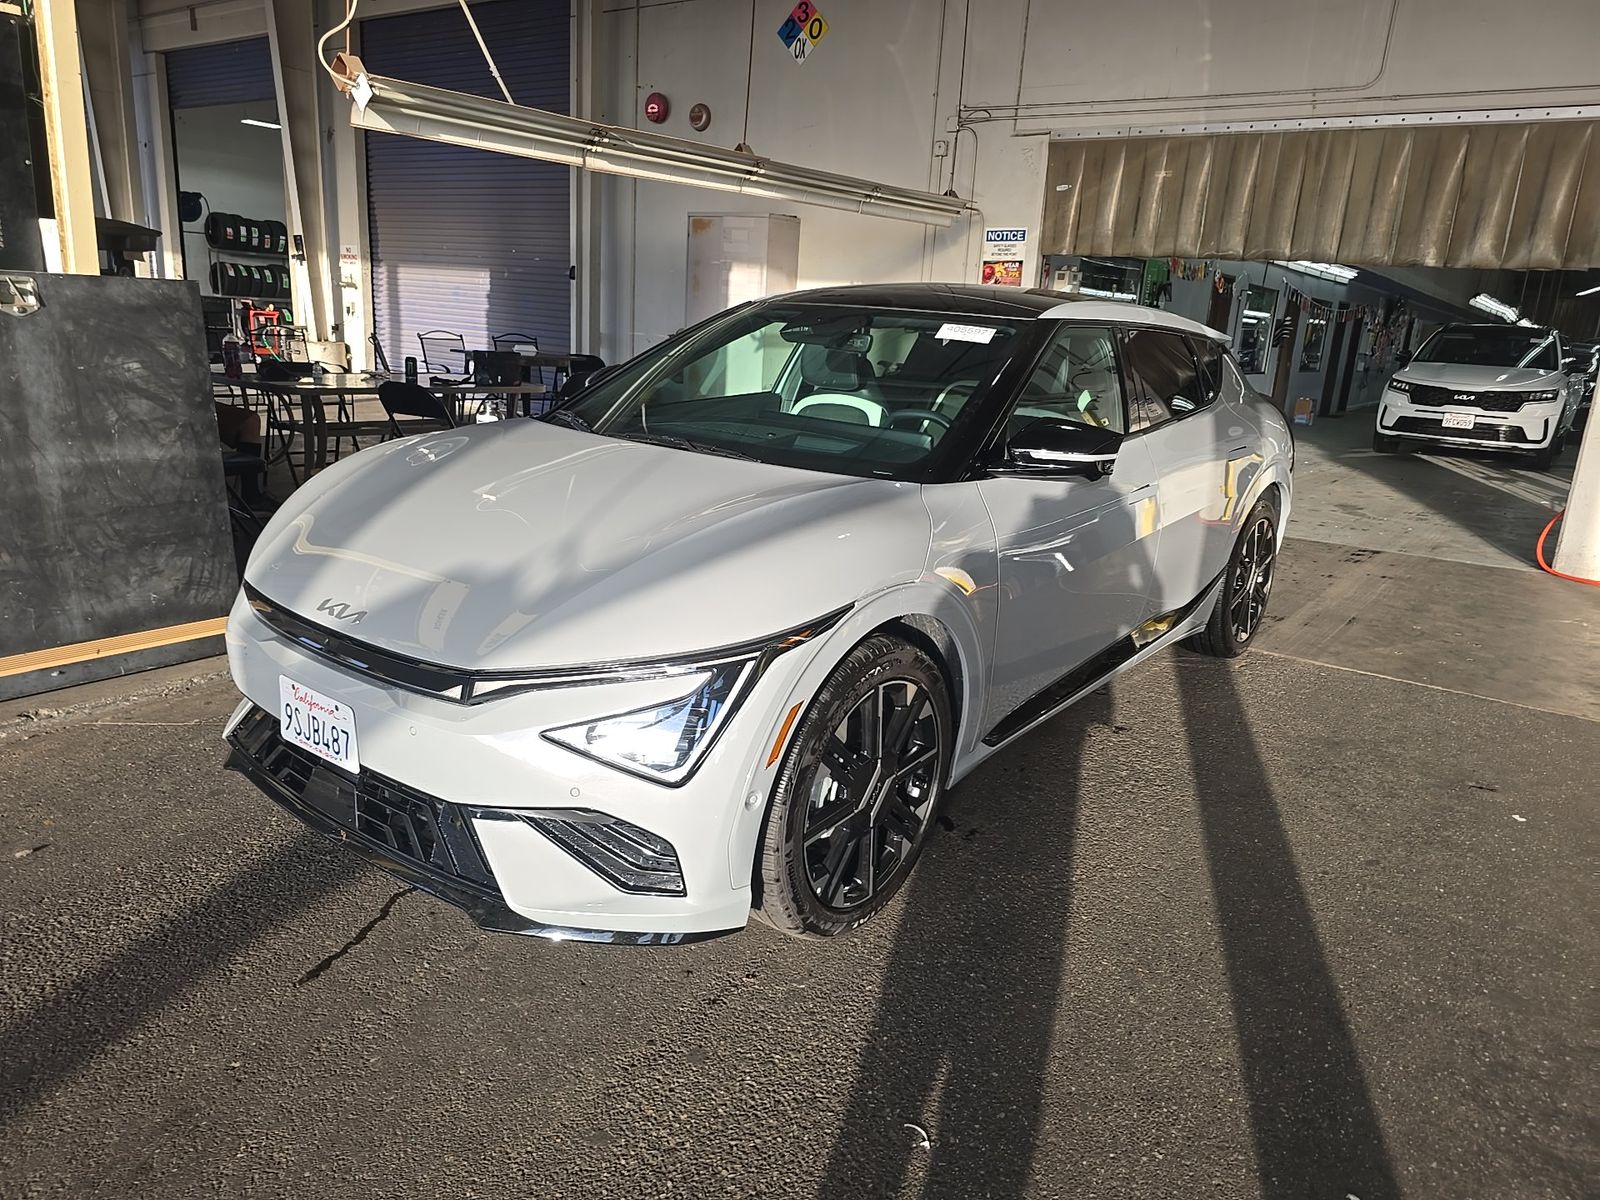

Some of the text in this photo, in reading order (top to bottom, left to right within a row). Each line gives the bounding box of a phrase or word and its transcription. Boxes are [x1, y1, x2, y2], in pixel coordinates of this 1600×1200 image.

[797, 1, 810, 23] 3
[785, 20, 796, 41] 2
[809, 17, 823, 40] 0
[794, 37, 807, 59] OX
[988, 231, 1024, 241] NOTICE
[316, 597, 368, 624] KIA
[293, 686, 341, 720] California
[284, 702, 350, 760] 9SJB487
